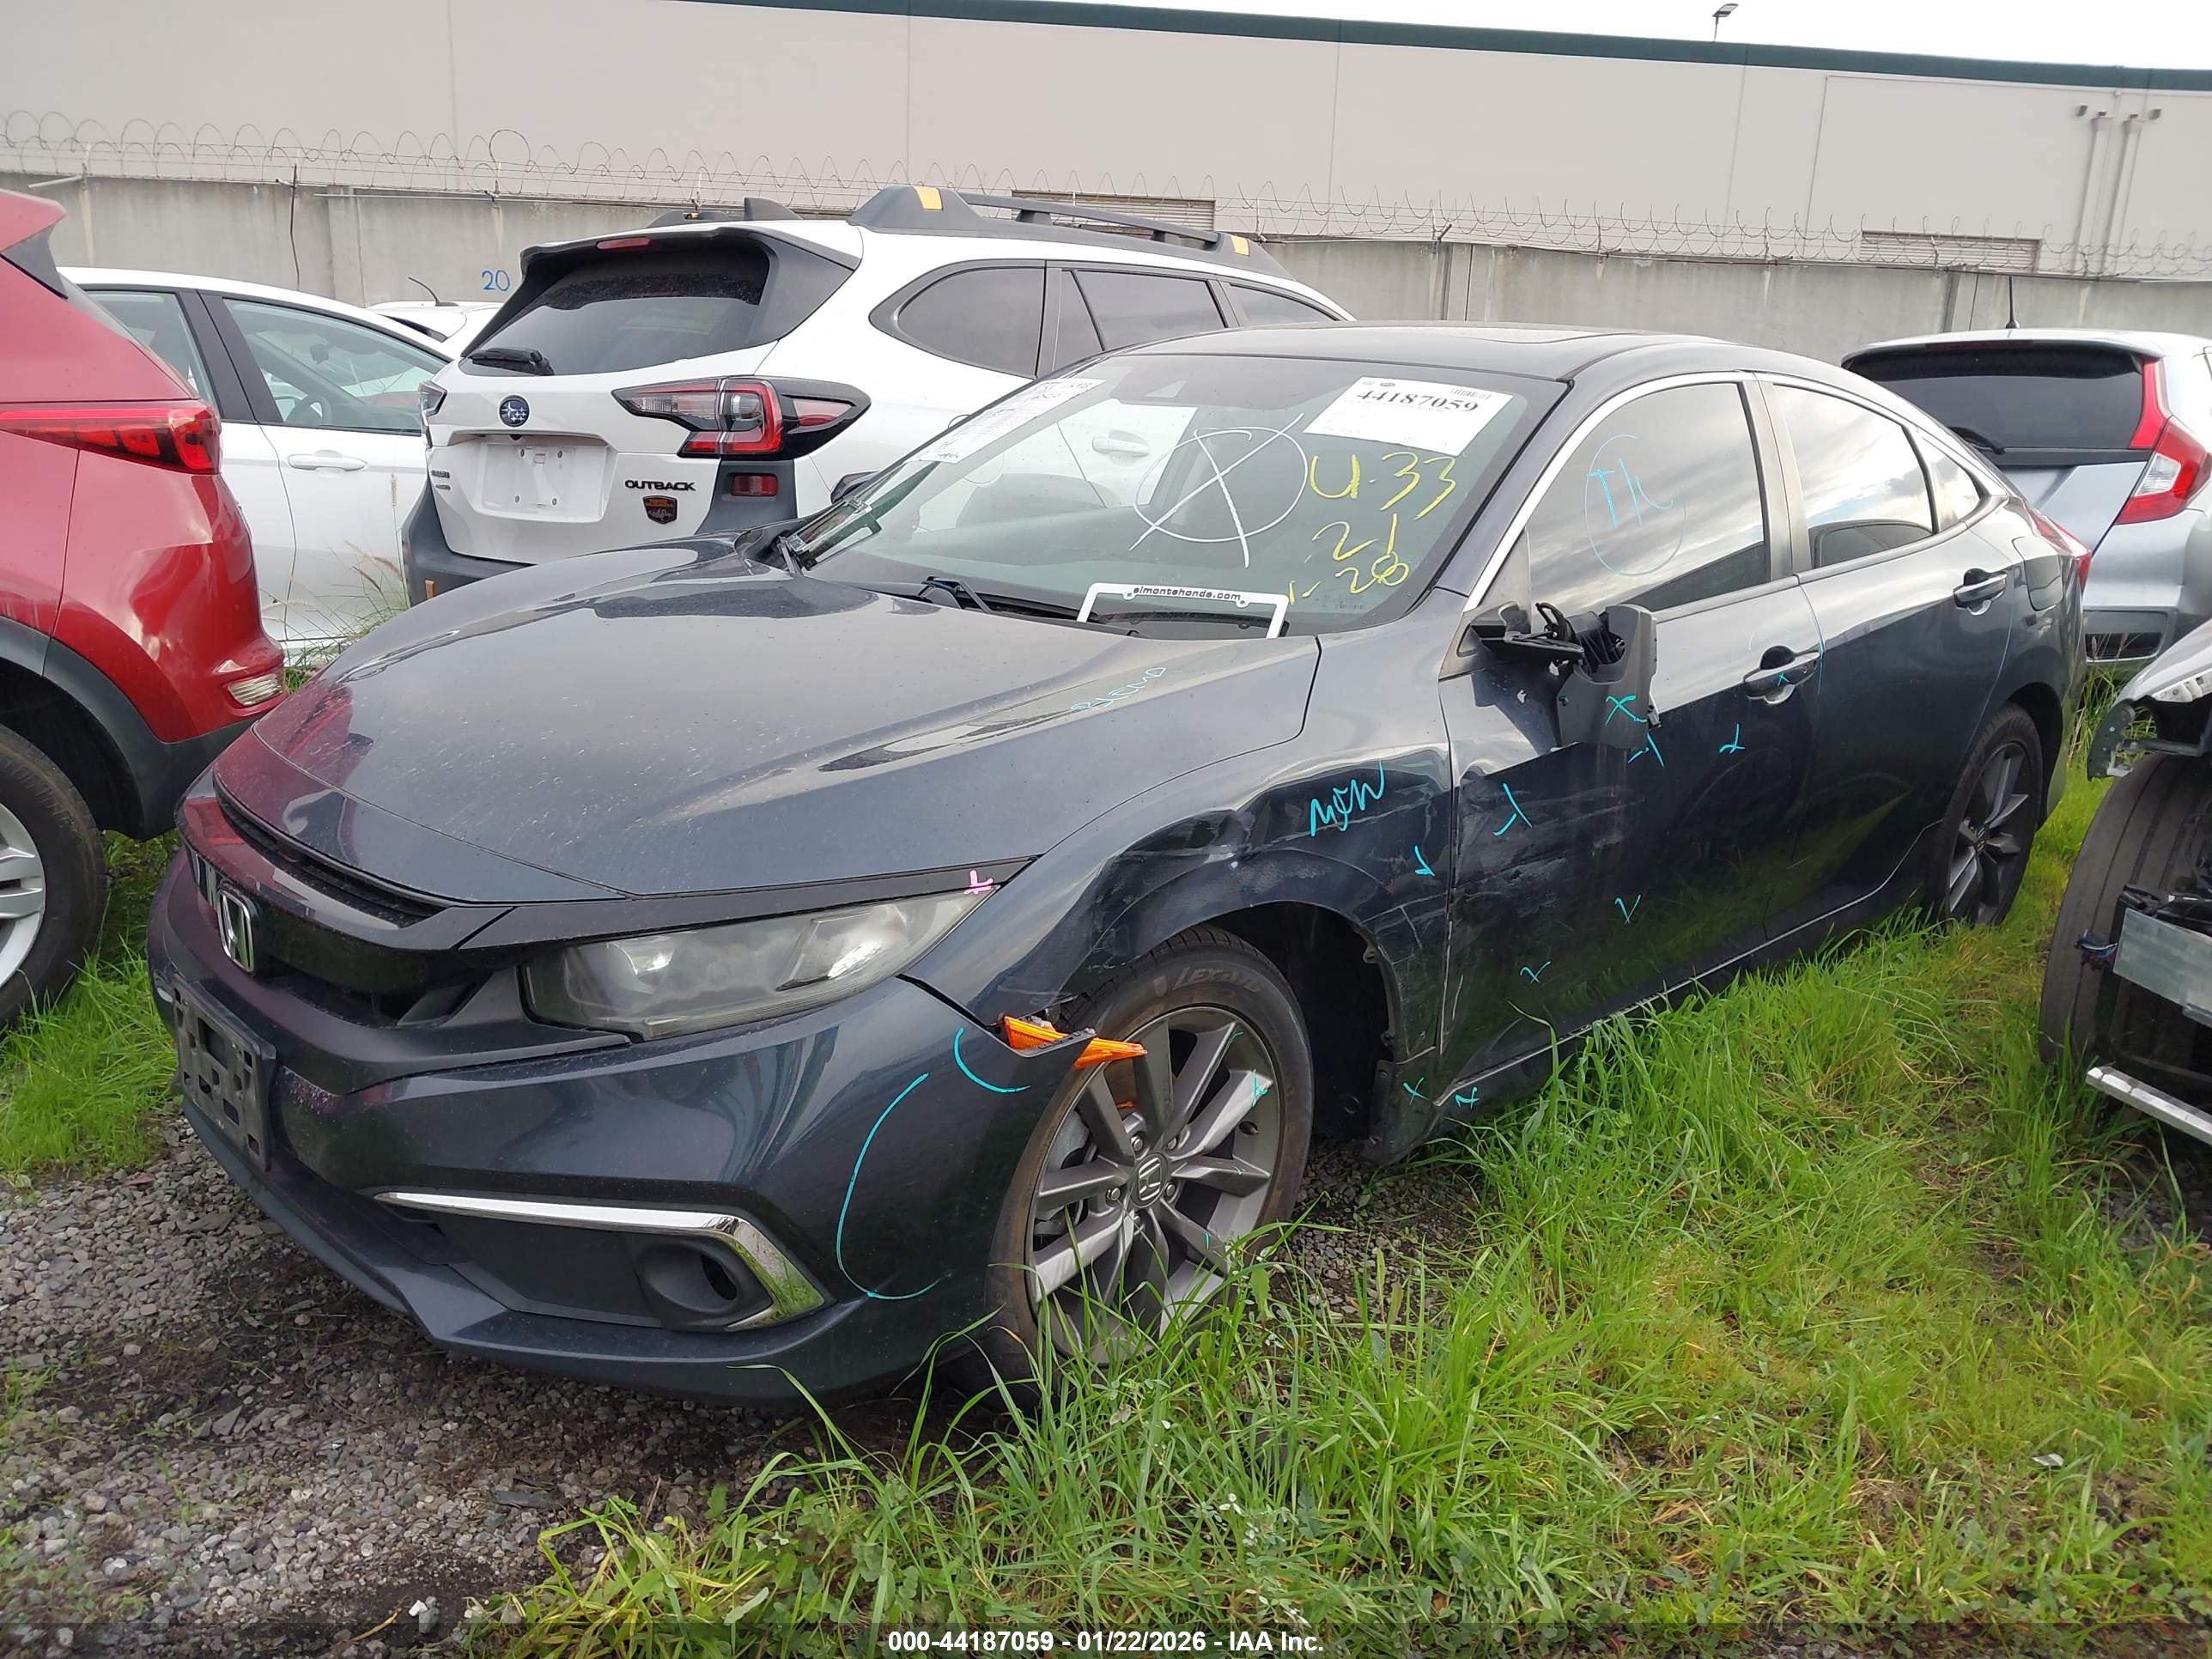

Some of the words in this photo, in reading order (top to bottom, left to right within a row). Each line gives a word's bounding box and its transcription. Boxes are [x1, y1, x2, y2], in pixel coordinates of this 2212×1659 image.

[482, 270, 510, 291] 20
[1357, 390, 1479, 412] 44187059
[624, 480, 696, 491] OUTBACK
